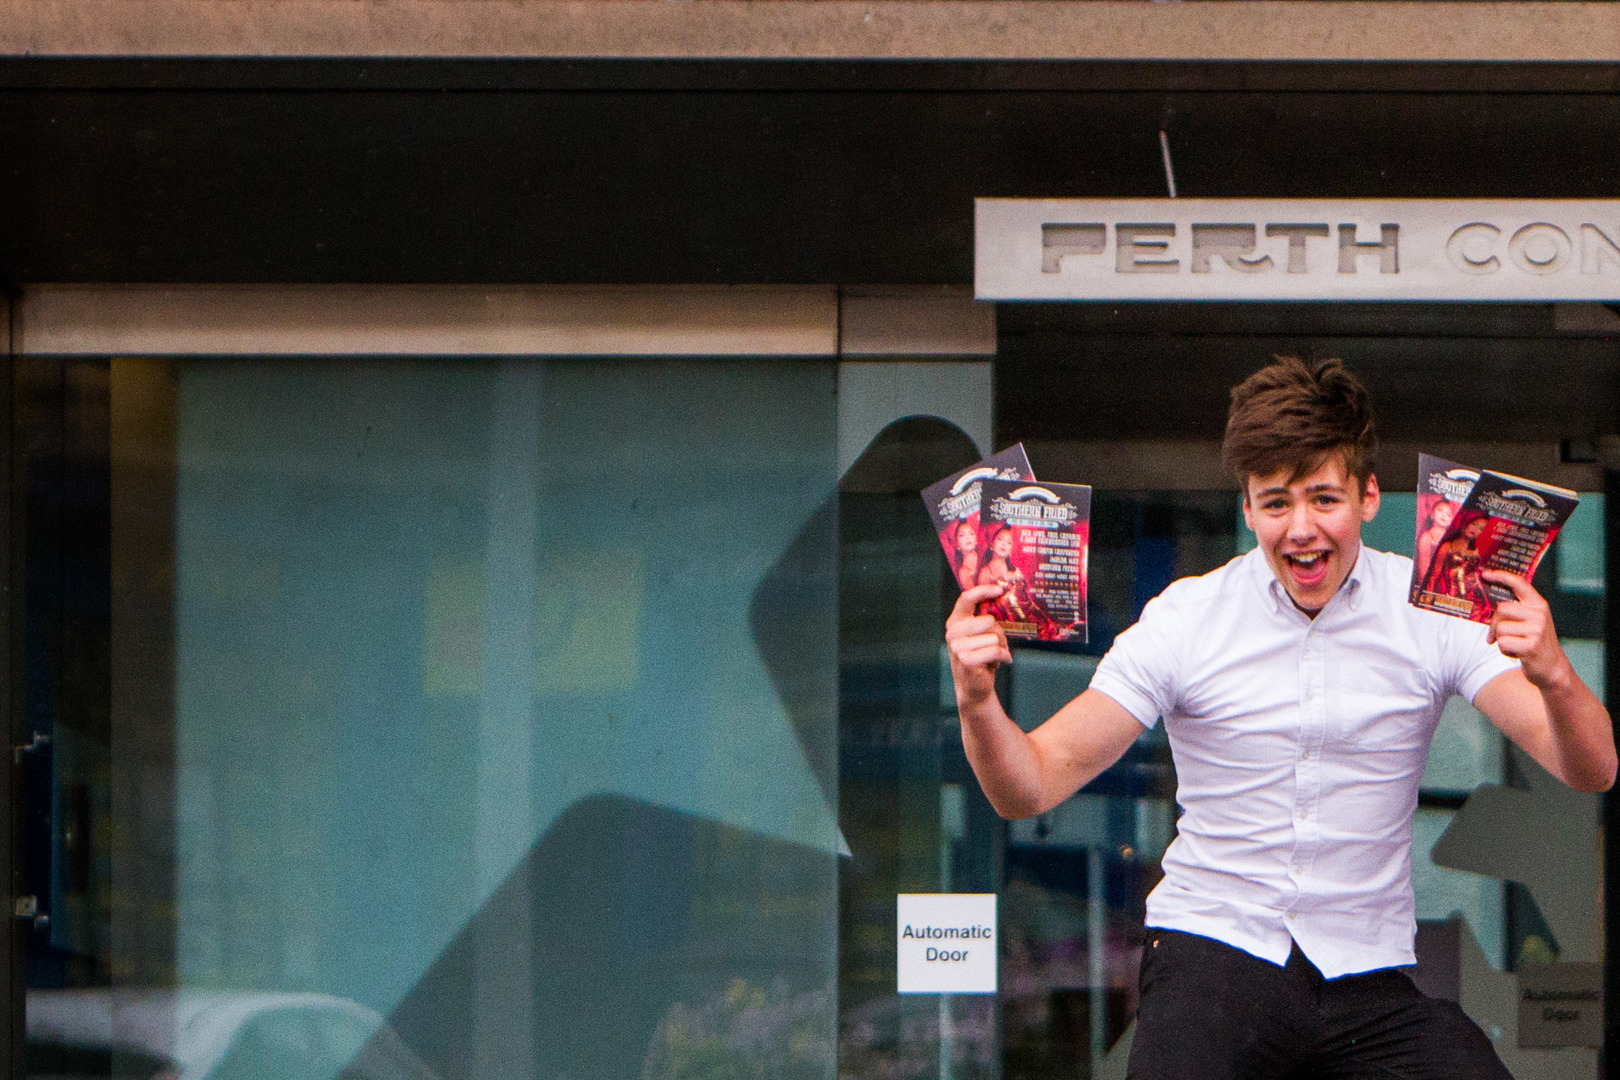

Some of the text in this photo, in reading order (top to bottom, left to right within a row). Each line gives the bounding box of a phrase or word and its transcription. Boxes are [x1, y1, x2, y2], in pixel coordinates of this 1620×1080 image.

[1041, 222, 1400, 274] PERTH
[947, 488, 982, 513] SOUTHER
[1000, 503, 1068, 520] SOUTHERN FRIED
[903, 925, 992, 939] Automatic
[926, 947, 968, 961] Door
